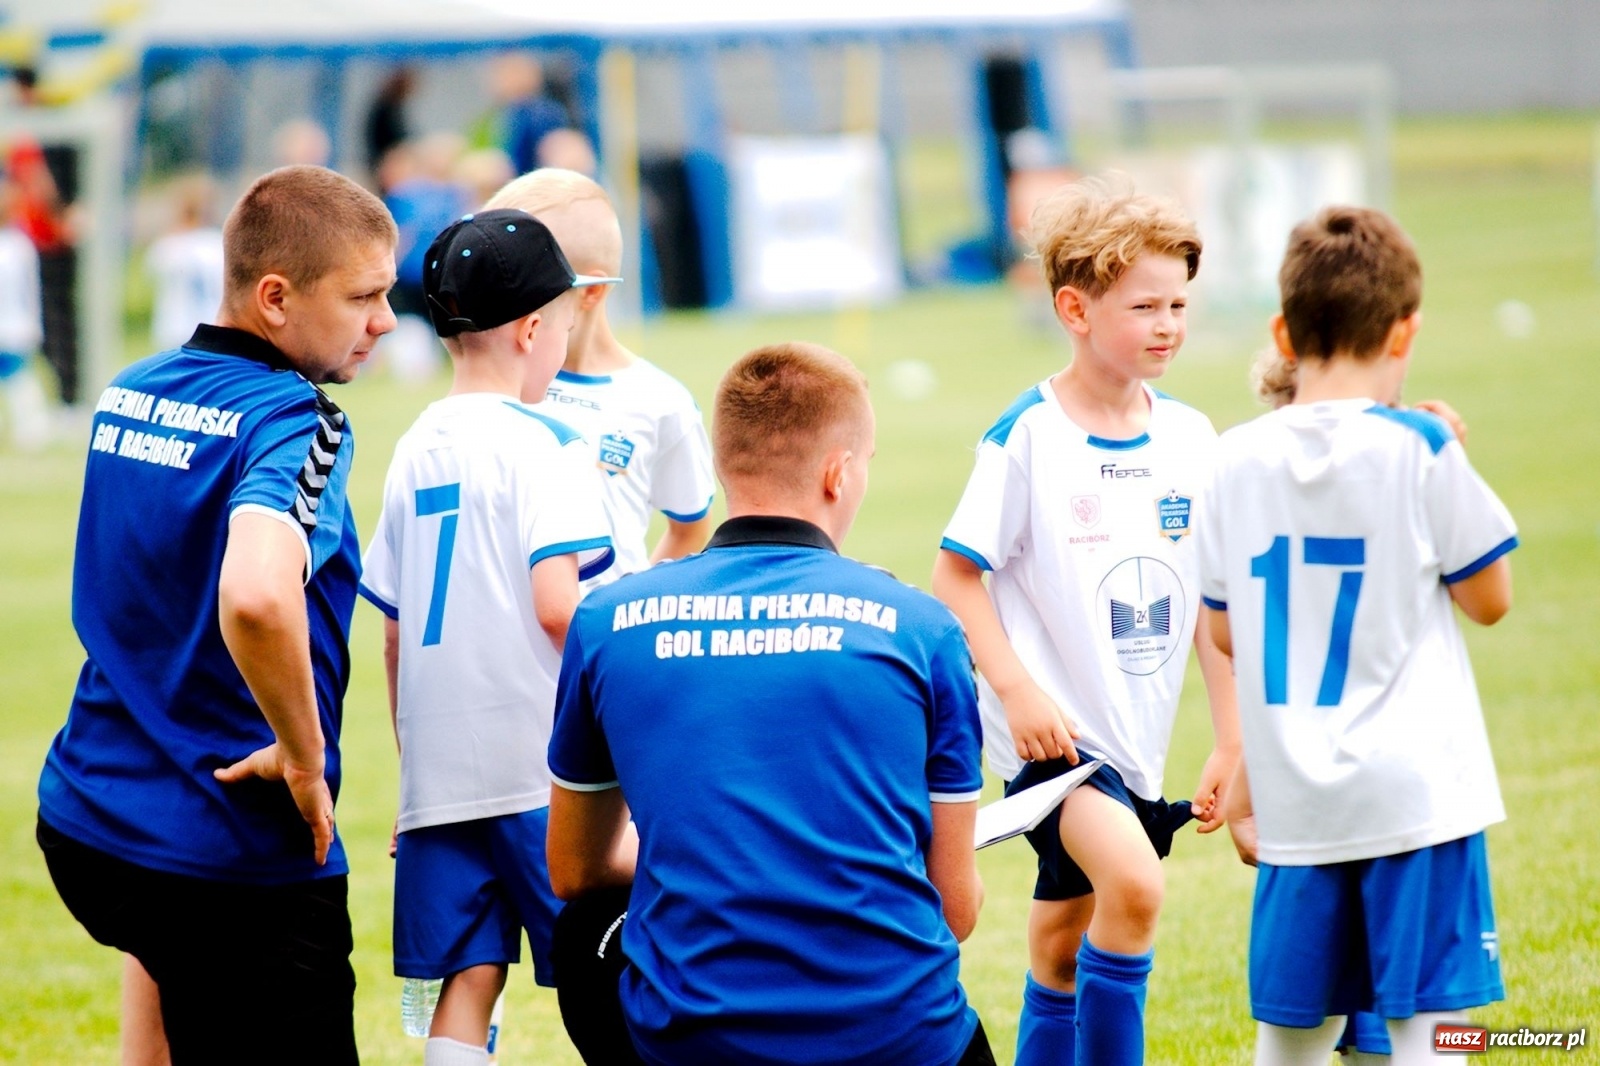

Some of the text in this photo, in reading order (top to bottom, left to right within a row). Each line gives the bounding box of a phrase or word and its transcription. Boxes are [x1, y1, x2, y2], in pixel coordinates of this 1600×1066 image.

[94, 386, 243, 437] ADEMIA PIŁKARSKA
[92, 423, 197, 470] GOL RACIBÓRZ
[604, 452, 625, 467] GOL
[1069, 534, 1110, 544] RACIBÓRZ
[1165, 517, 1185, 528] GOL
[415, 482, 460, 647] 7
[612, 593, 897, 633] AKADEMIA PIŁKARSKA
[1251, 535, 1366, 706] 17
[655, 623, 844, 659] GOL RACIBÓRZ
